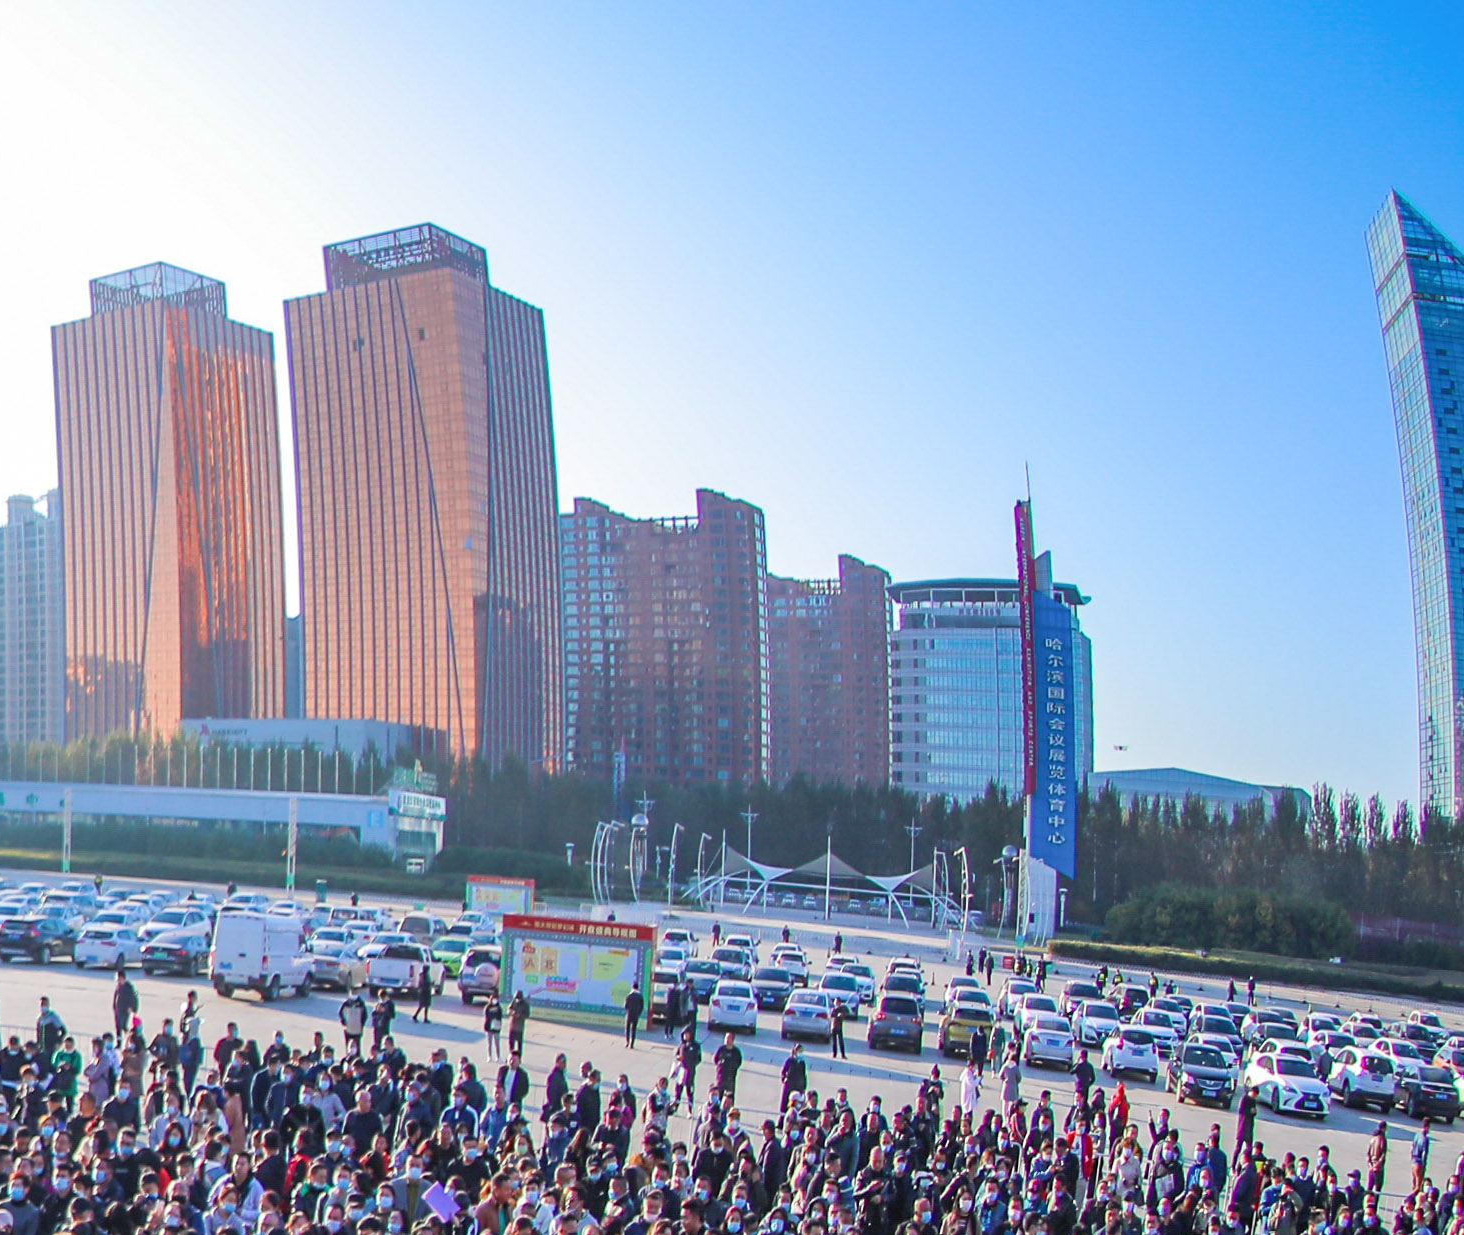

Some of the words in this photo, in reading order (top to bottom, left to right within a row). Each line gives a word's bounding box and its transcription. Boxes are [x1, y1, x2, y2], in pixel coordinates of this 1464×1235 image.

[1045, 638, 1066, 845] 哈尔滨国际会议展览体育中心
